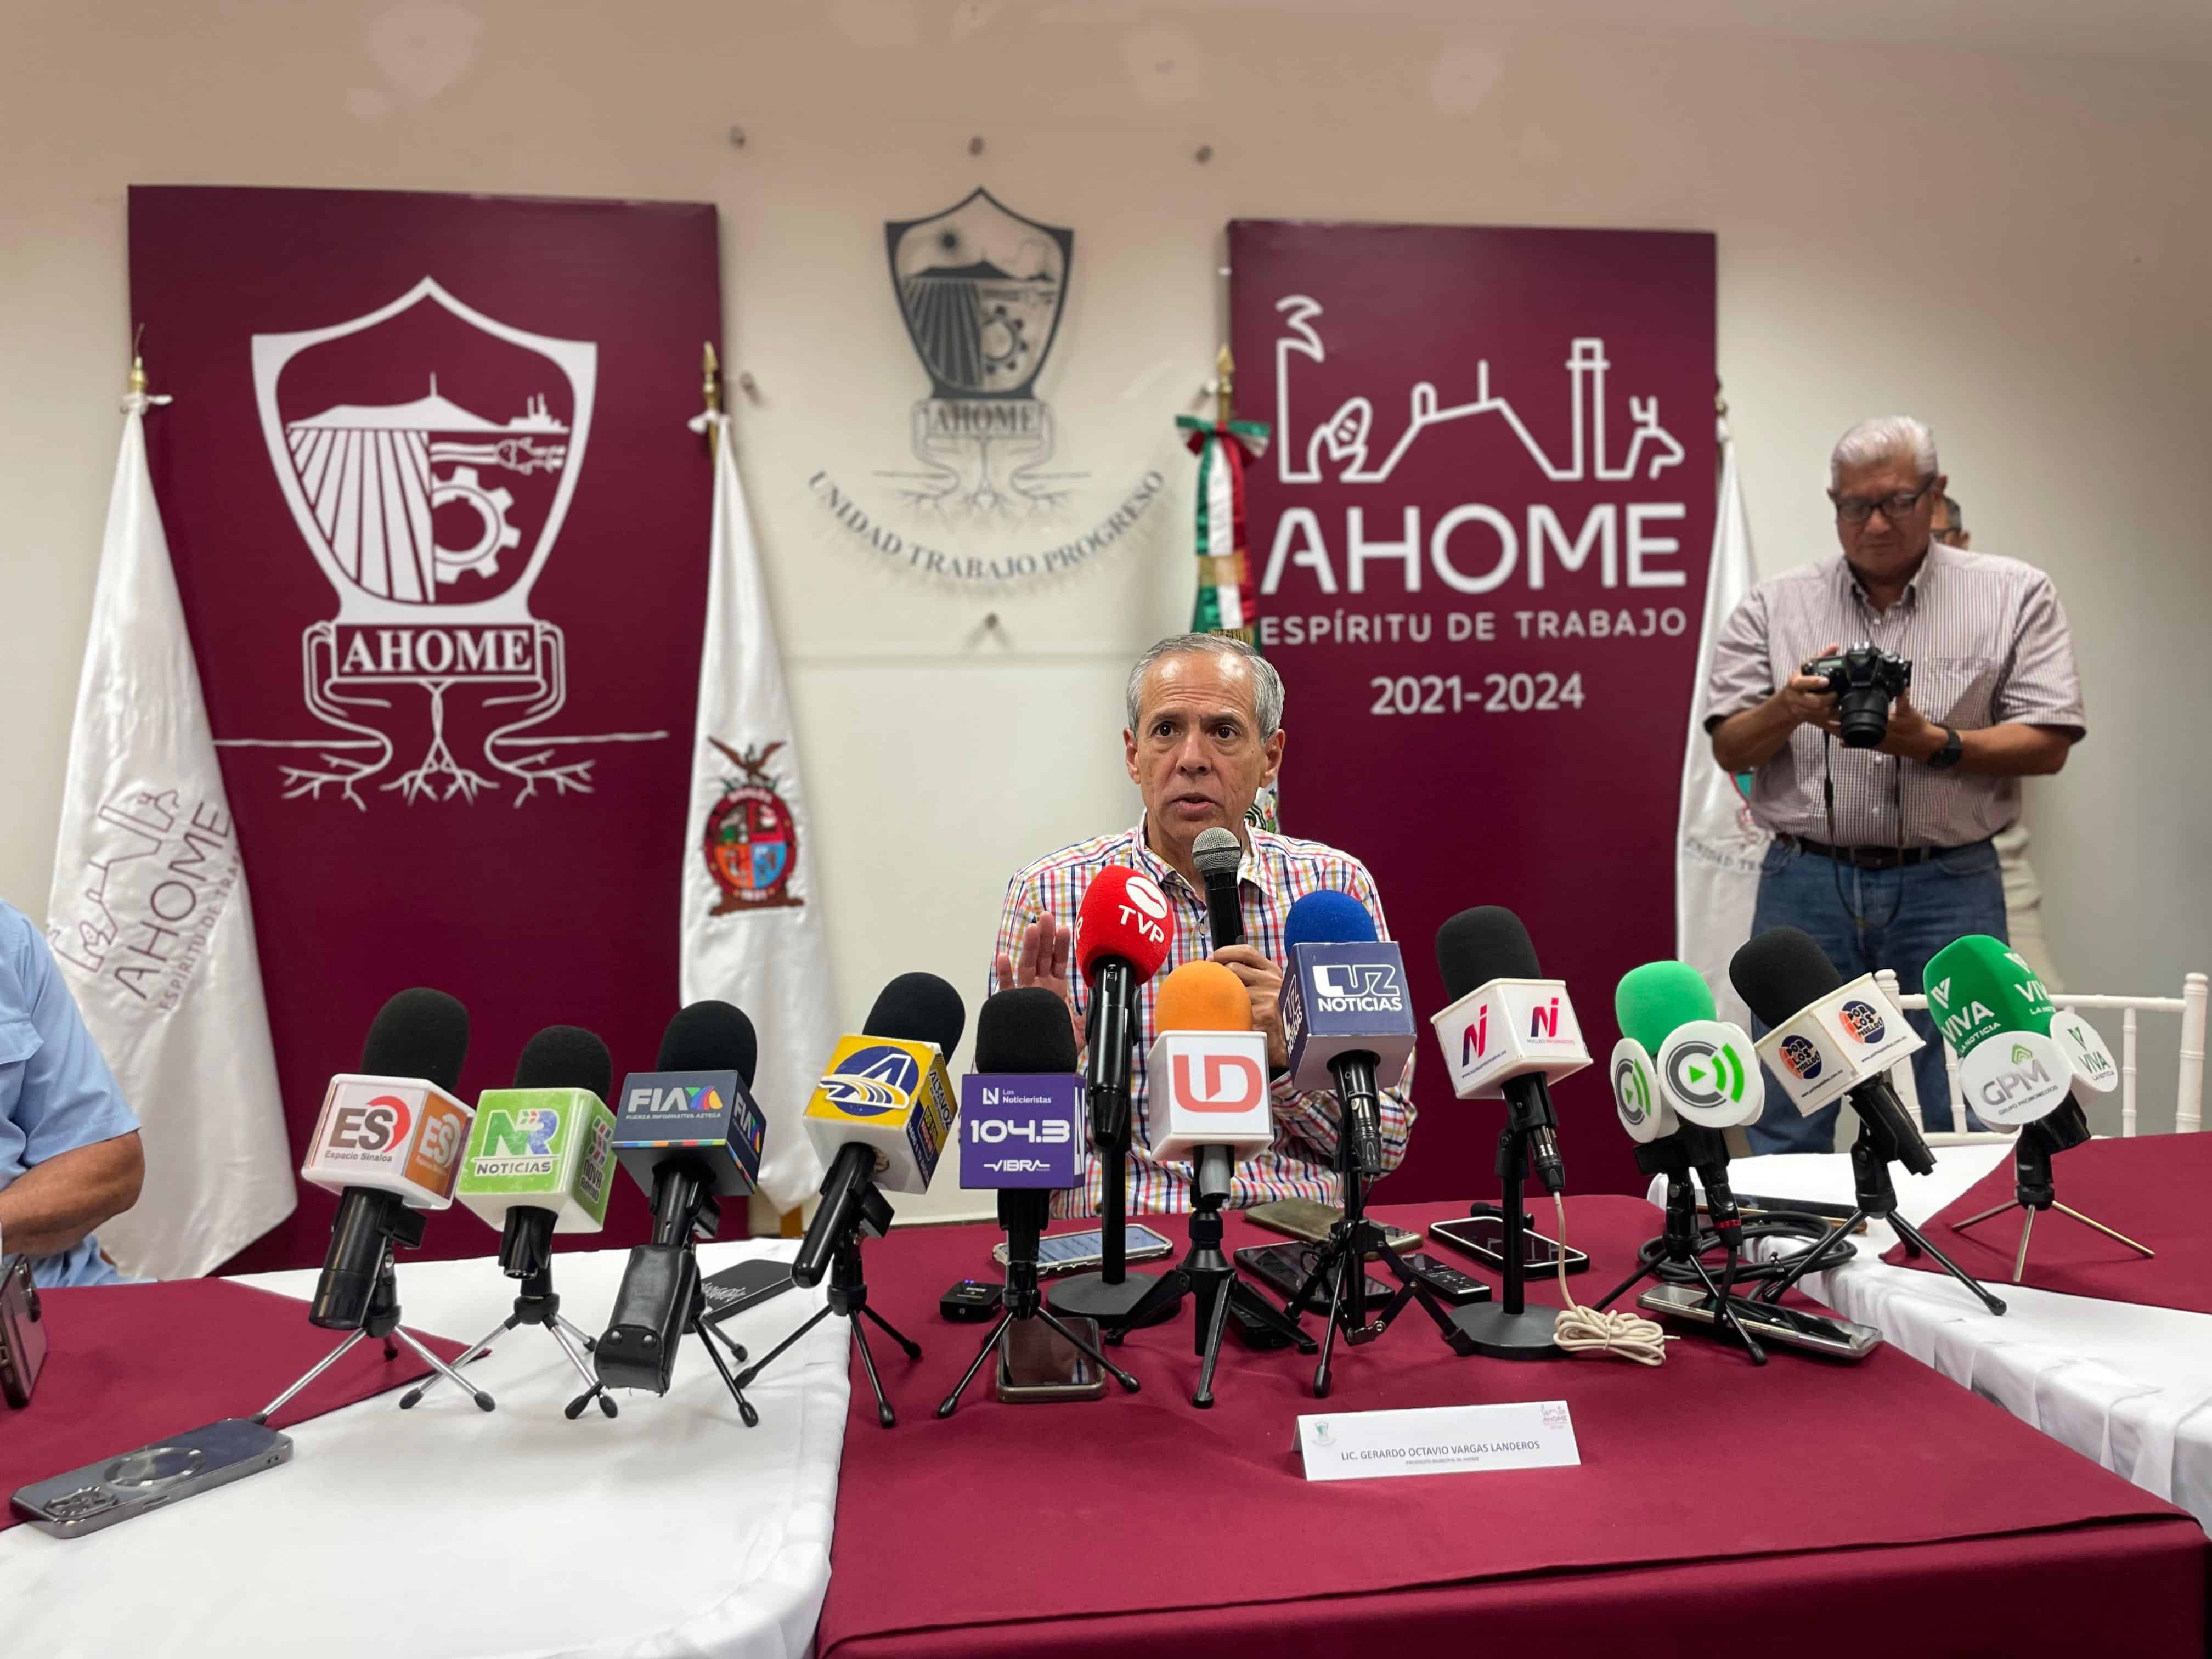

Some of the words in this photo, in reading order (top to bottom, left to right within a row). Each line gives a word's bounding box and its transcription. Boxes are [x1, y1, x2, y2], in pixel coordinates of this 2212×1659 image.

[933, 404, 1033, 433] AHOME
[809, 470, 902, 557] UNIDAD
[909, 545, 1036, 581] TRABAJO
[1044, 470, 1165, 574] PROGRESO
[1260, 502, 1688, 595] AHOME
[1261, 609, 1432, 646] ESPÍRITU
[1448, 613, 1496, 641] DE
[1515, 608, 1688, 638] TRABAJO
[341, 629, 532, 673] AHOME
[1370, 673, 1585, 715] 2021-2024
[114, 802, 233, 1000] AHOME
[1118, 905, 1164, 943] TVP
[1312, 964, 1400, 997] LUZ
[1317, 997, 1402, 1012] NOTICIAS
[1847, 1006, 1868, 1021] POR
[1853, 1014, 1875, 1030] LOS
[1940, 1001, 1995, 1043] VIVA
[1965, 1022, 2001, 1047] NOTICIA
[1792, 1048, 1811, 1065] LOS
[2078, 1051, 2111, 1074] VIVA
[1982, 1059, 2050, 1106] GPM
[329, 1107, 393, 1150] ES
[970, 1120, 1070, 1143] 104.3
[325, 1150, 358, 1161] Espacio
[361, 1153, 392, 1162] Sinaloa
[476, 1161, 551, 1175] NOTICIAS
[984, 1159, 1050, 1172] VIBRA
[1341, 1451, 1358, 1461] LIC.
[1360, 1448, 1406, 1460] GERARDO
[1408, 1445, 1449, 1457] OCTAVIO
[1451, 1443, 1489, 1455] VARGAS
[1490, 1440, 1541, 1452] LANDEROS
